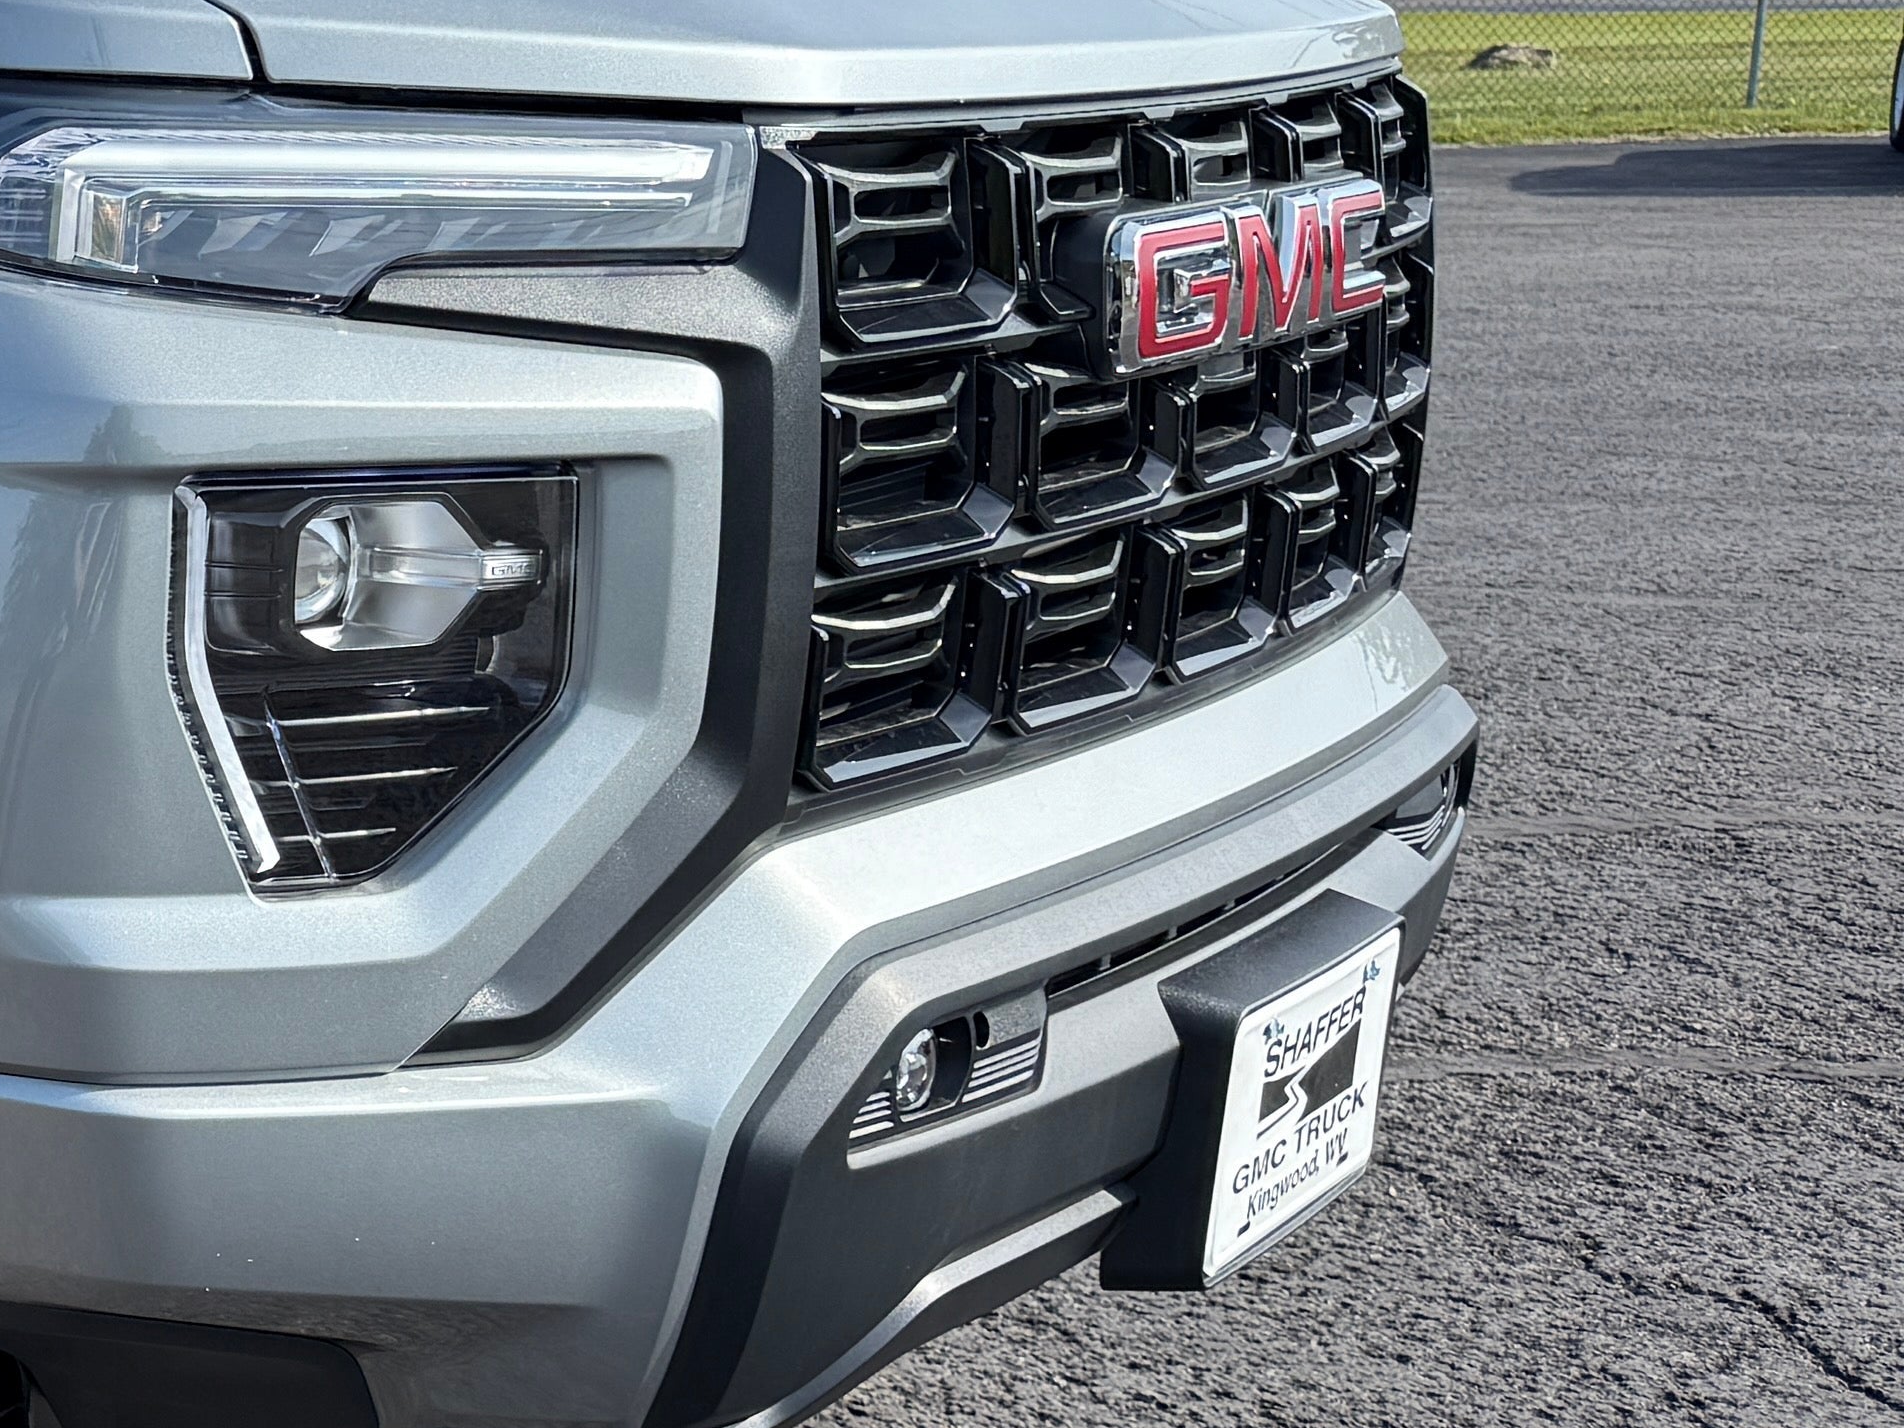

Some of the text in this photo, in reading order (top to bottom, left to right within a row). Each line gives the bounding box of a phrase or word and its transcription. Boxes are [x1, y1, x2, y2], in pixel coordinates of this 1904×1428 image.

[1122, 182, 1387, 370] GMC
[1264, 986, 1367, 1079] SHAFFER
[1232, 1082, 1367, 1195] GMC TRUCK
[1247, 1128, 1349, 1218] Kingwood, WV
